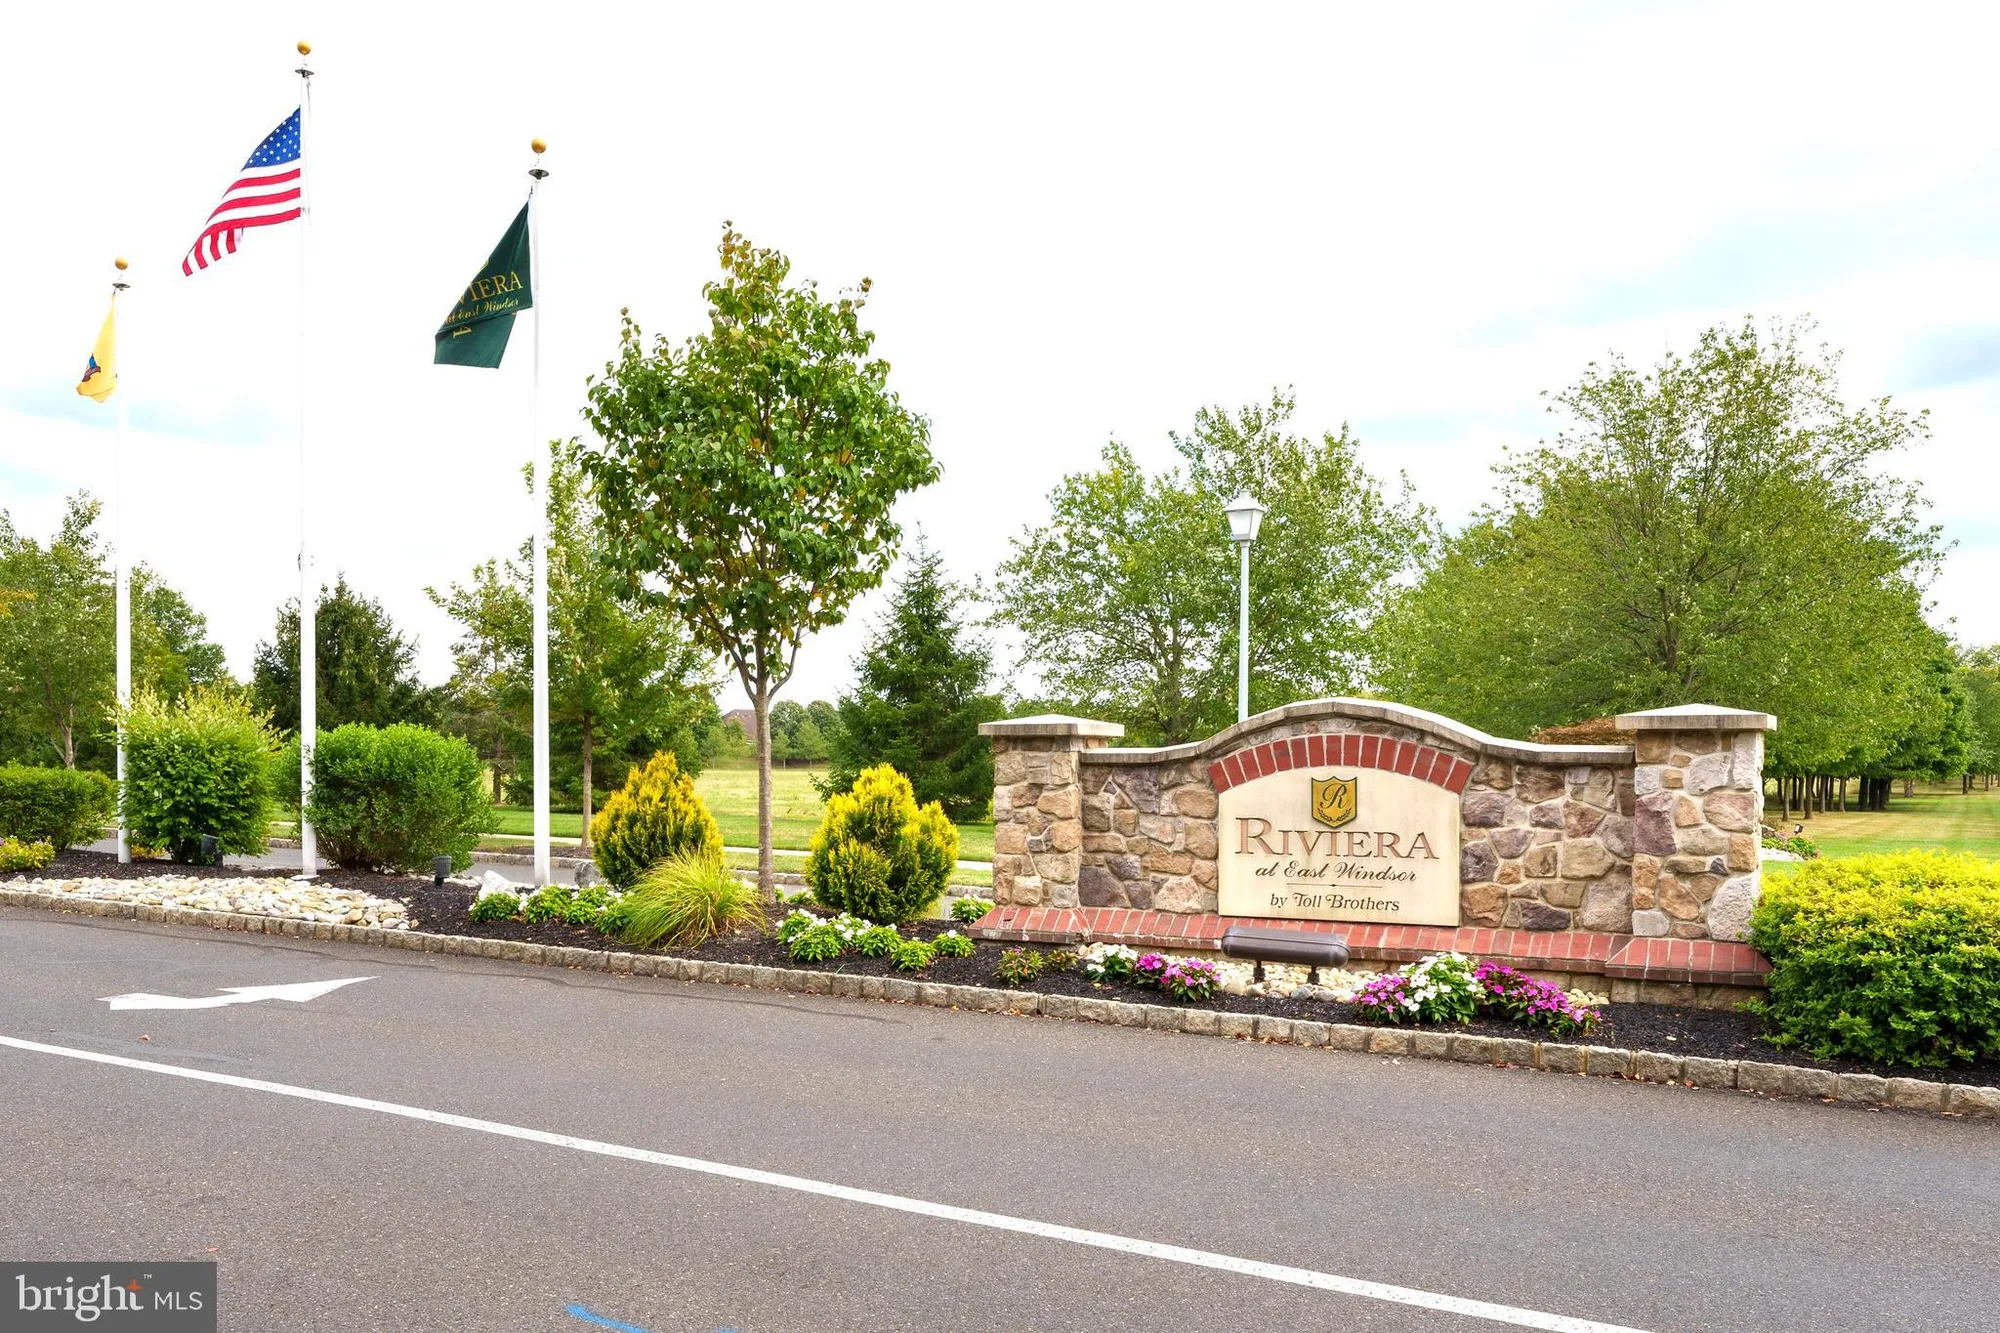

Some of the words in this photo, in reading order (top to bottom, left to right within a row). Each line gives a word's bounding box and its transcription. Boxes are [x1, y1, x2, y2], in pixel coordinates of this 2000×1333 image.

[484, 297, 519, 313] Windsor
[1320, 783, 1348, 809] R
[1235, 817, 1439, 860] RIVIERA
[1255, 862, 1278, 878] at
[1284, 860, 1328, 879] East
[1333, 861, 1417, 882] Windsor
[1270, 893, 1288, 908] by
[1293, 892, 1322, 908] Toll
[1325, 894, 1400, 912] Brothers
